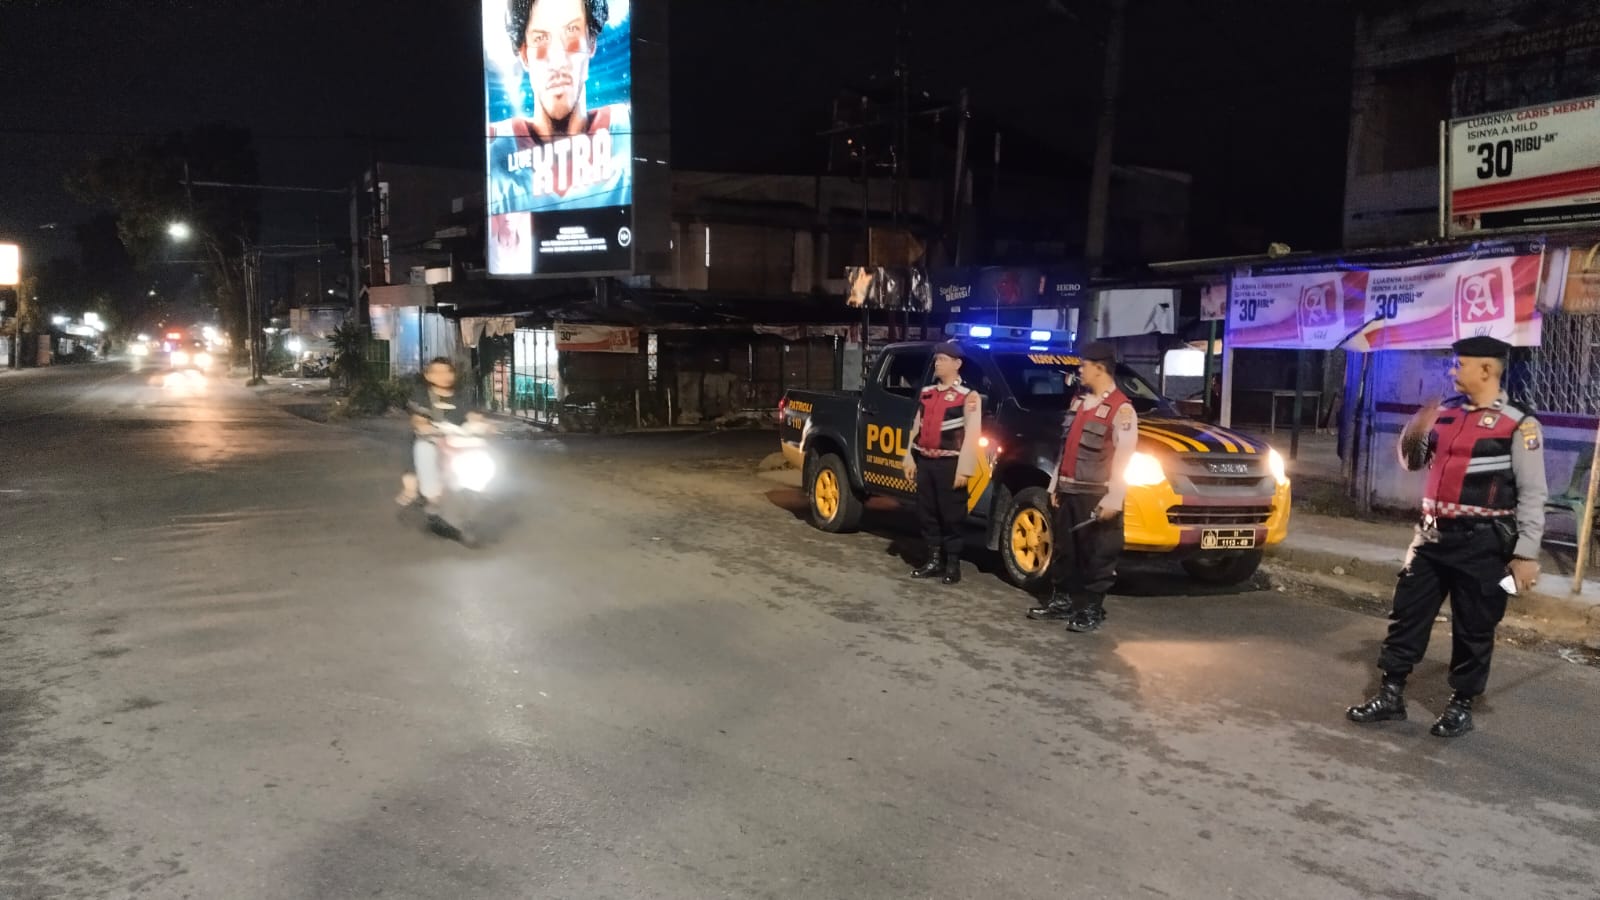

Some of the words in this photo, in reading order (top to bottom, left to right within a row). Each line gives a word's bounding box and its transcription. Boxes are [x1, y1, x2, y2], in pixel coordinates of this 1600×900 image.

[1467, 113, 1514, 129] LUARNYA
[1516, 108, 1550, 121] GARIS
[1552, 100, 1596, 116] MERAH
[1467, 127, 1499, 140] ISINYA
[1501, 126, 1509, 135] A
[1511, 121, 1538, 133] MILD
[532, 128, 612, 196] XTRA
[1477, 139, 1514, 179] 30
[1238, 298, 1257, 322] 30
[788, 400, 813, 413] PATROLI
[791, 416, 802, 430] 110
[866, 423, 908, 457] POL
